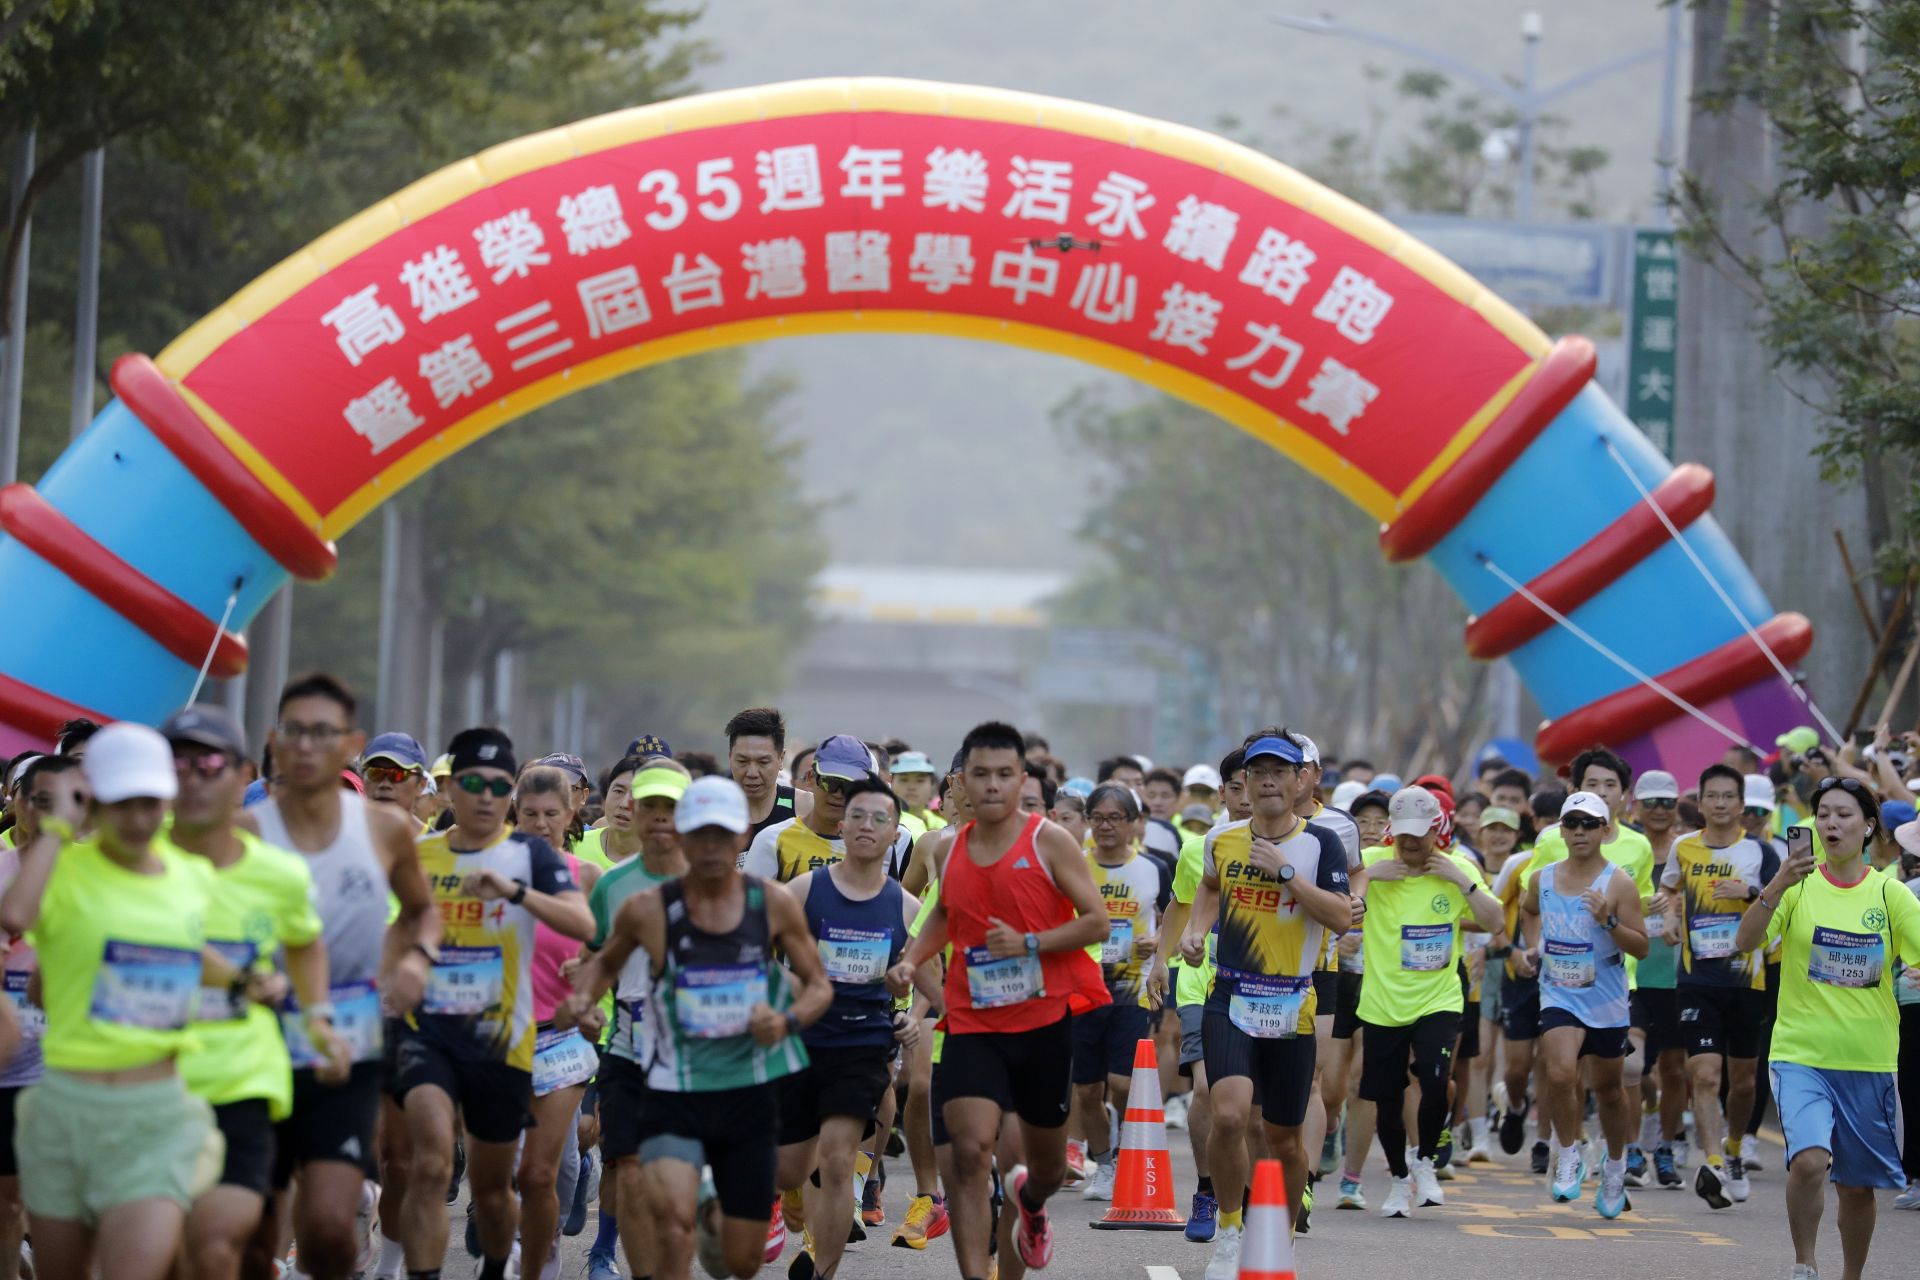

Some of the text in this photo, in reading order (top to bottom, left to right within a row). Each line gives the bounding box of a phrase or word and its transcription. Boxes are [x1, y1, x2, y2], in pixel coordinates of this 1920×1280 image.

[321, 144, 1394, 367] 高雄榮總35週年樂活永續路跑
[343, 230, 1380, 456] 暨第三屆台灣醫學中心接力賽
[1692, 863, 1732, 877] 台中山
[1828, 950, 1867, 967] 邱光明
[847, 963, 870, 974] 1093
[1841, 968, 1864, 978] 1253
[1001, 982, 1024, 993] 1109
[1247, 1001, 1283, 1015] 李政宏
[1259, 1018, 1280, 1028] 1199
[1145, 1157, 1156, 1196] KSD
